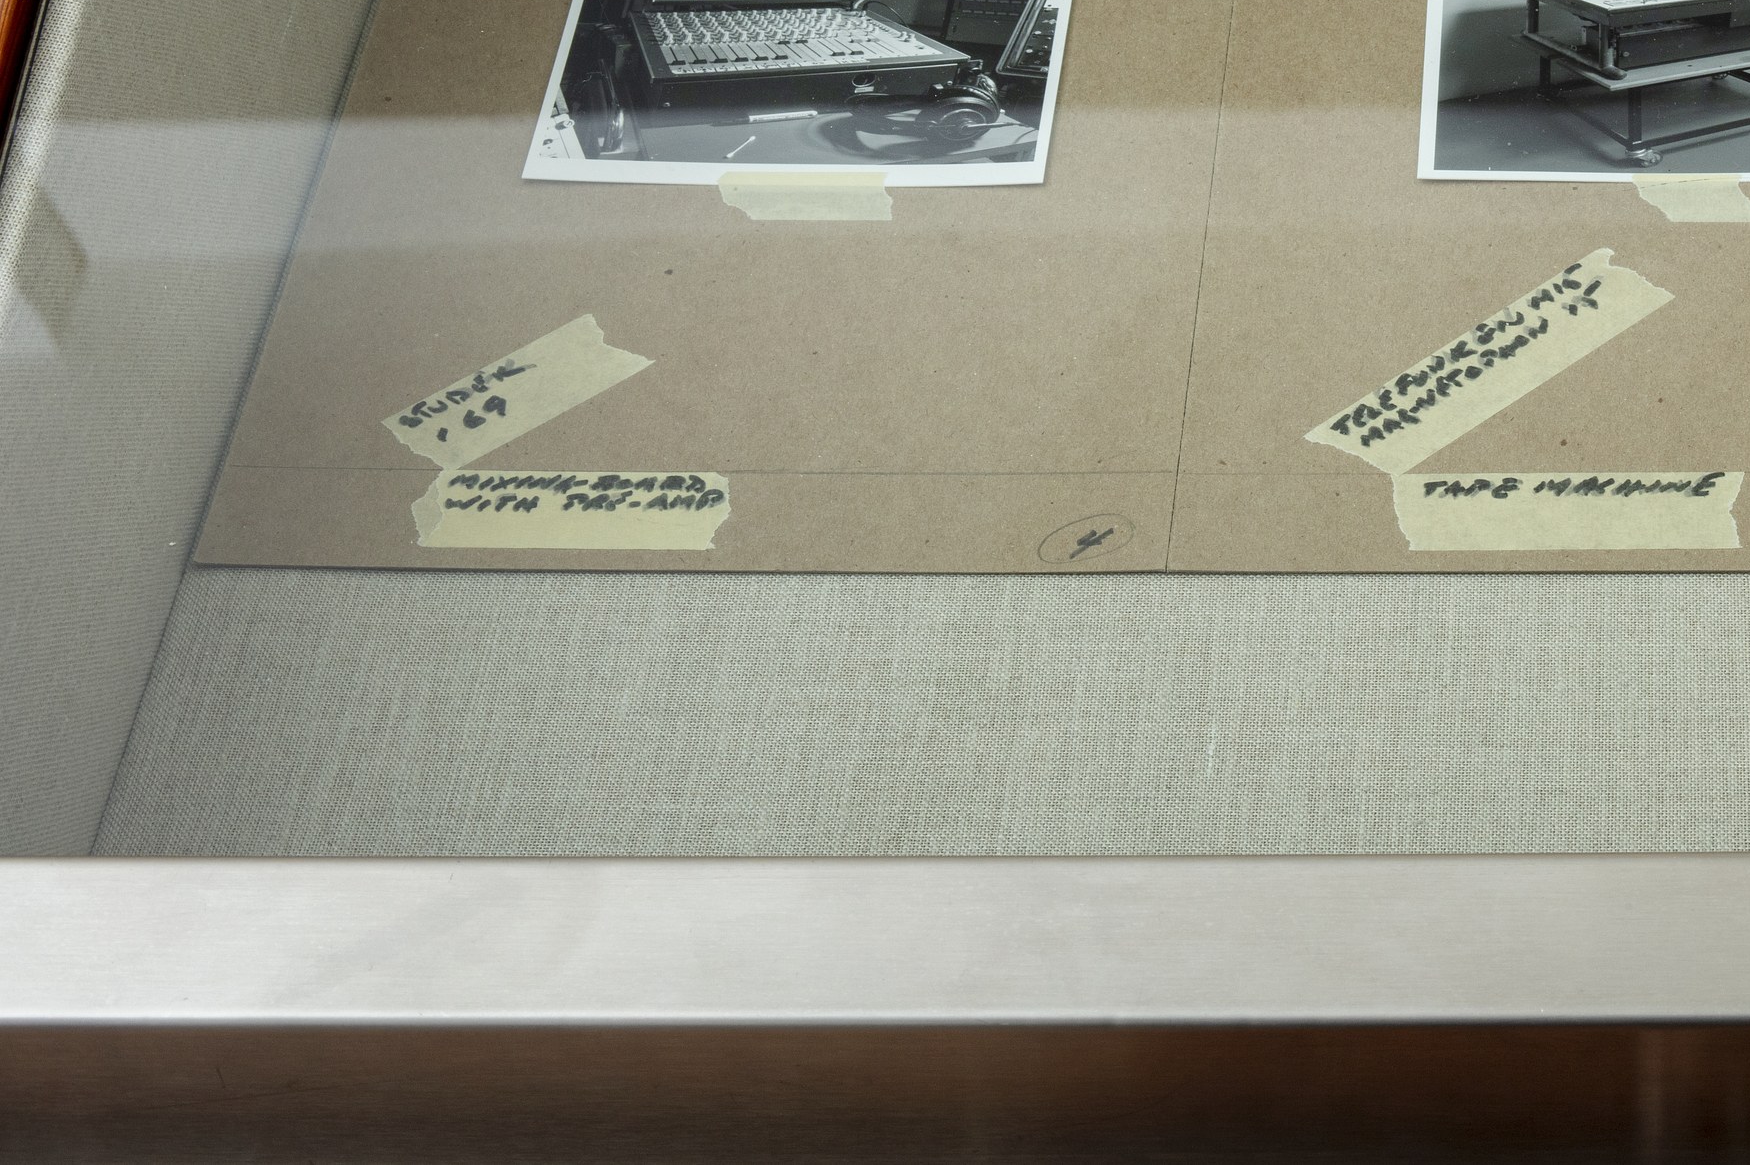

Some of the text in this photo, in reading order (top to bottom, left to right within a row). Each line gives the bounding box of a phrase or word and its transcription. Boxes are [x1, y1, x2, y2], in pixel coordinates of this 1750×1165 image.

[1424, 471, 1726, 499] TAPE MACHINE
[444, 495, 540, 513] WITH
